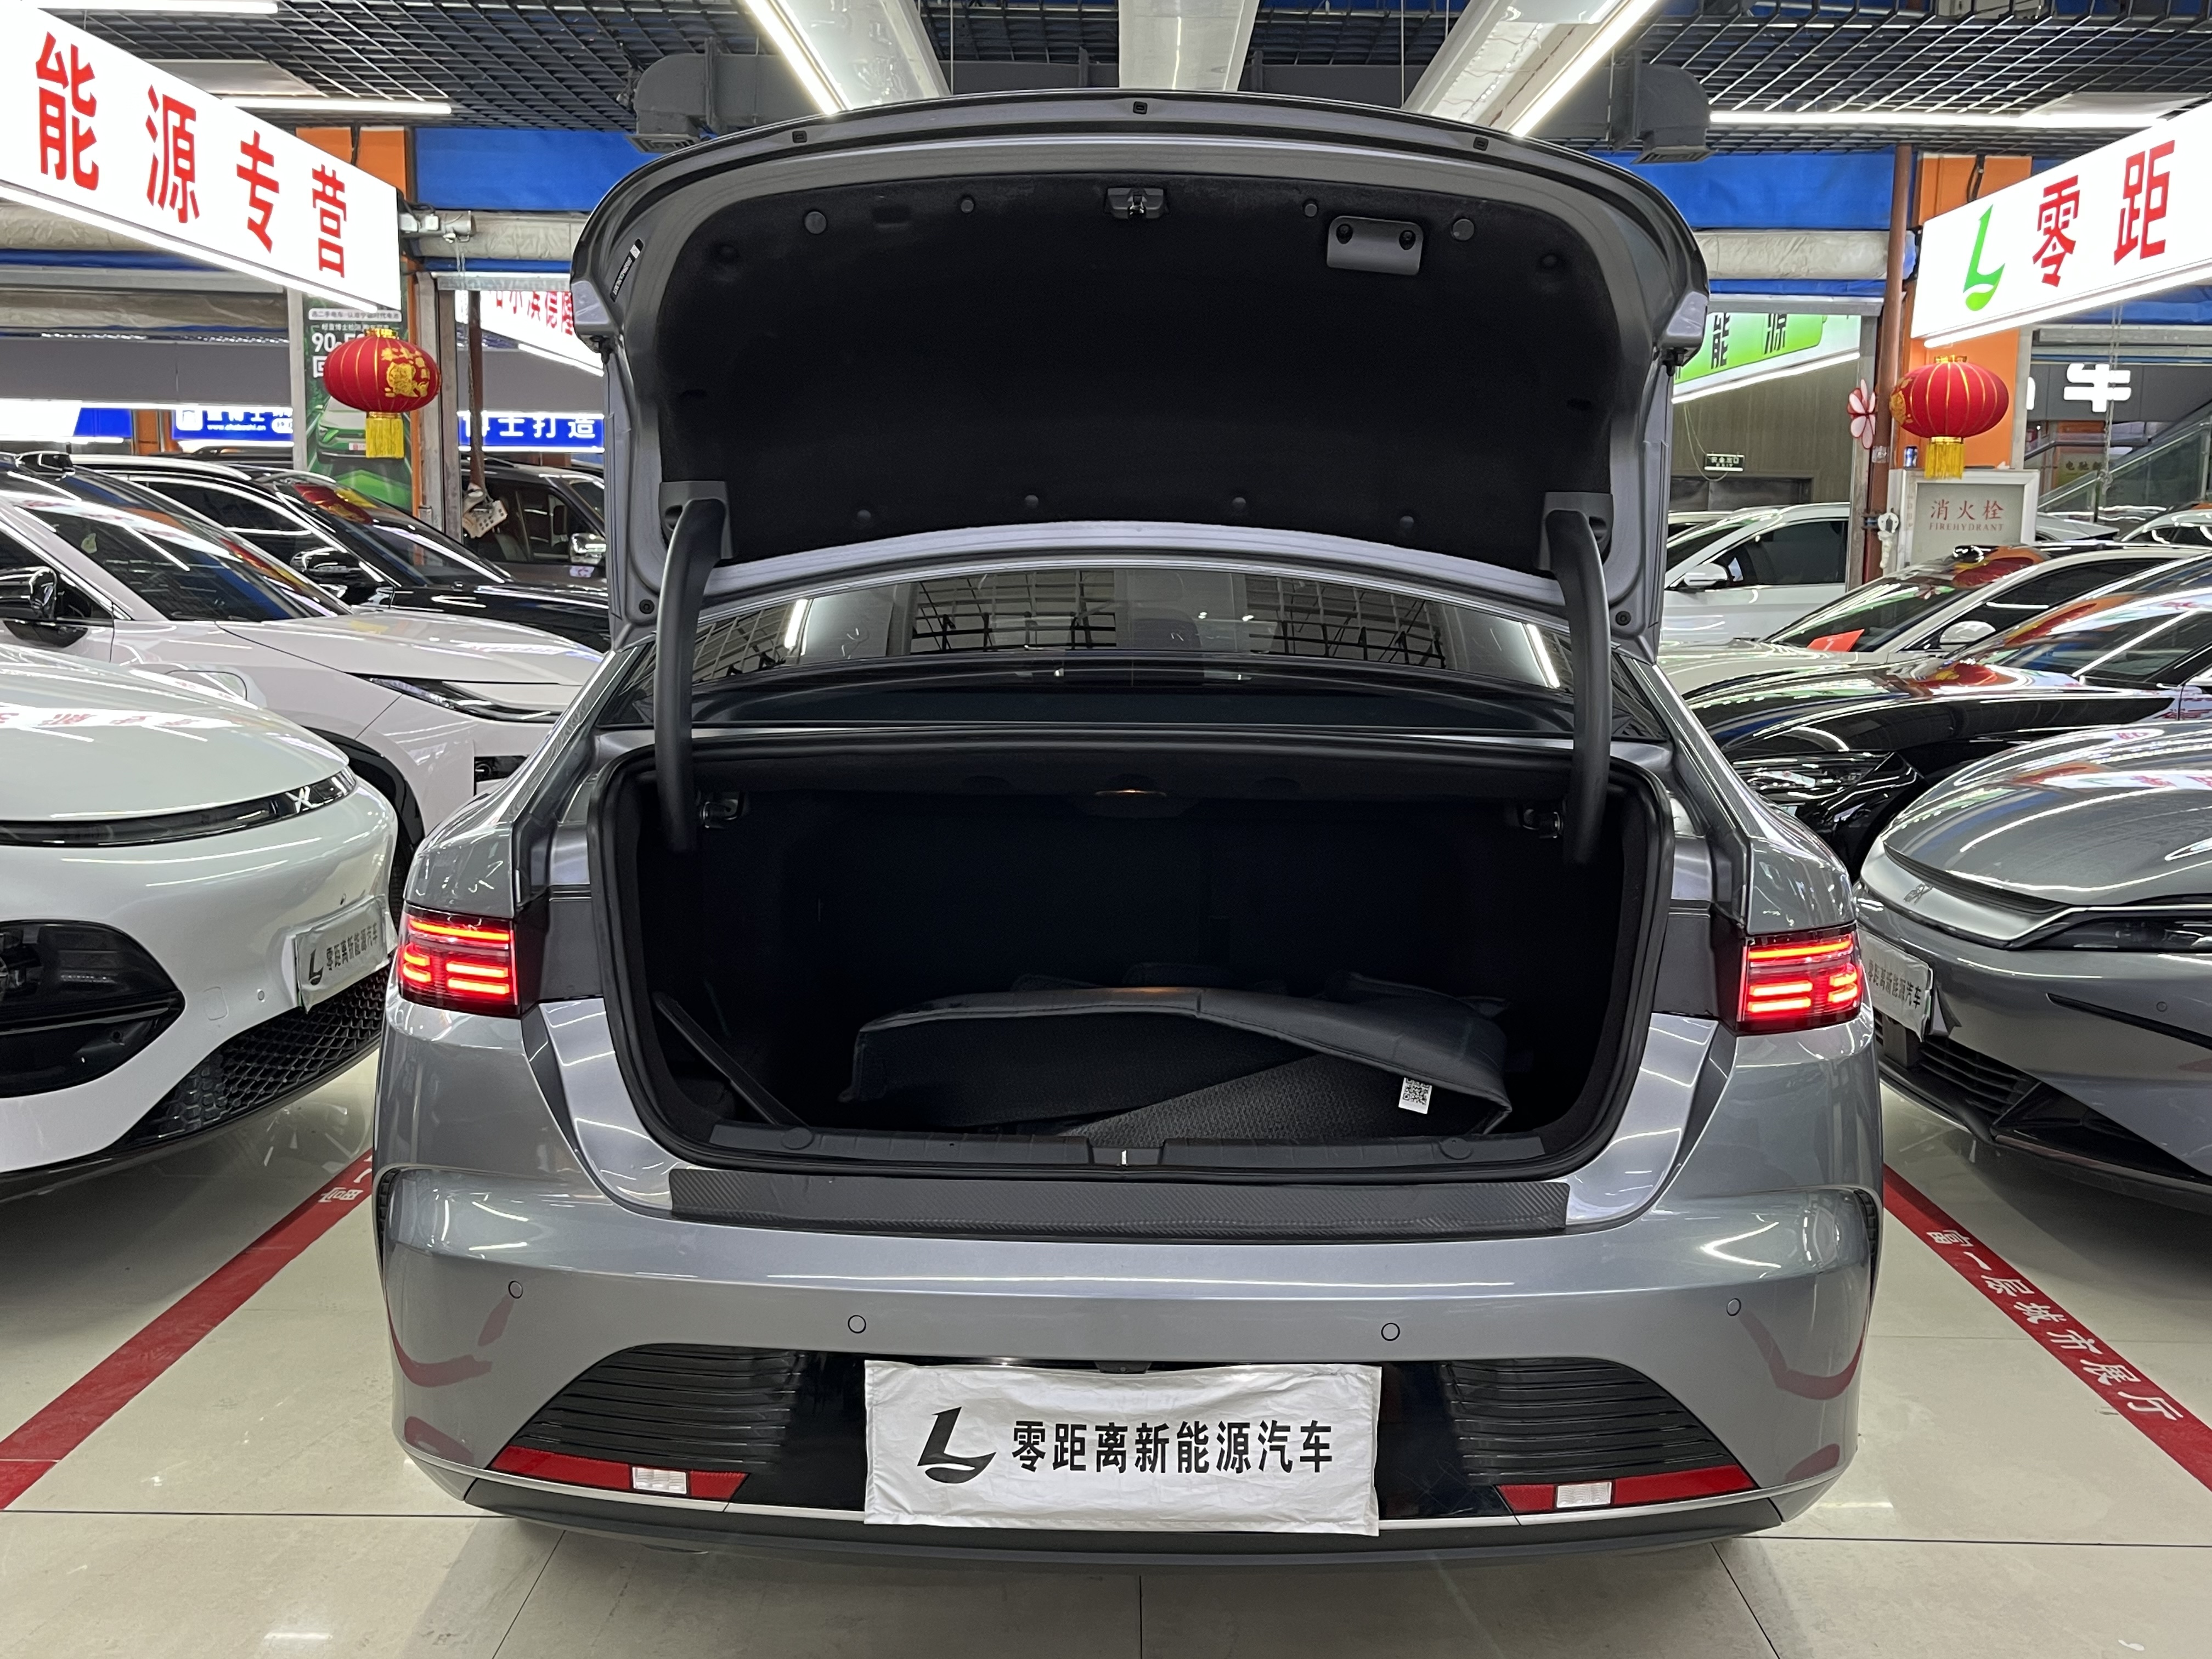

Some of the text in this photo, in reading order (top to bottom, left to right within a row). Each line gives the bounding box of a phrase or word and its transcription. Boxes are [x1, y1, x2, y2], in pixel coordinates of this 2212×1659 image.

[35, 31, 347, 279] 能源专营
[2032, 139, 2176, 287] 零距
[1674, 312, 1788, 380] 能源
[1929, 522, 2005, 532] FIREHYDRANT
[1930, 499, 2005, 521] 消火栓
[1012, 1419, 1333, 1475] 零距离新能源汽车
